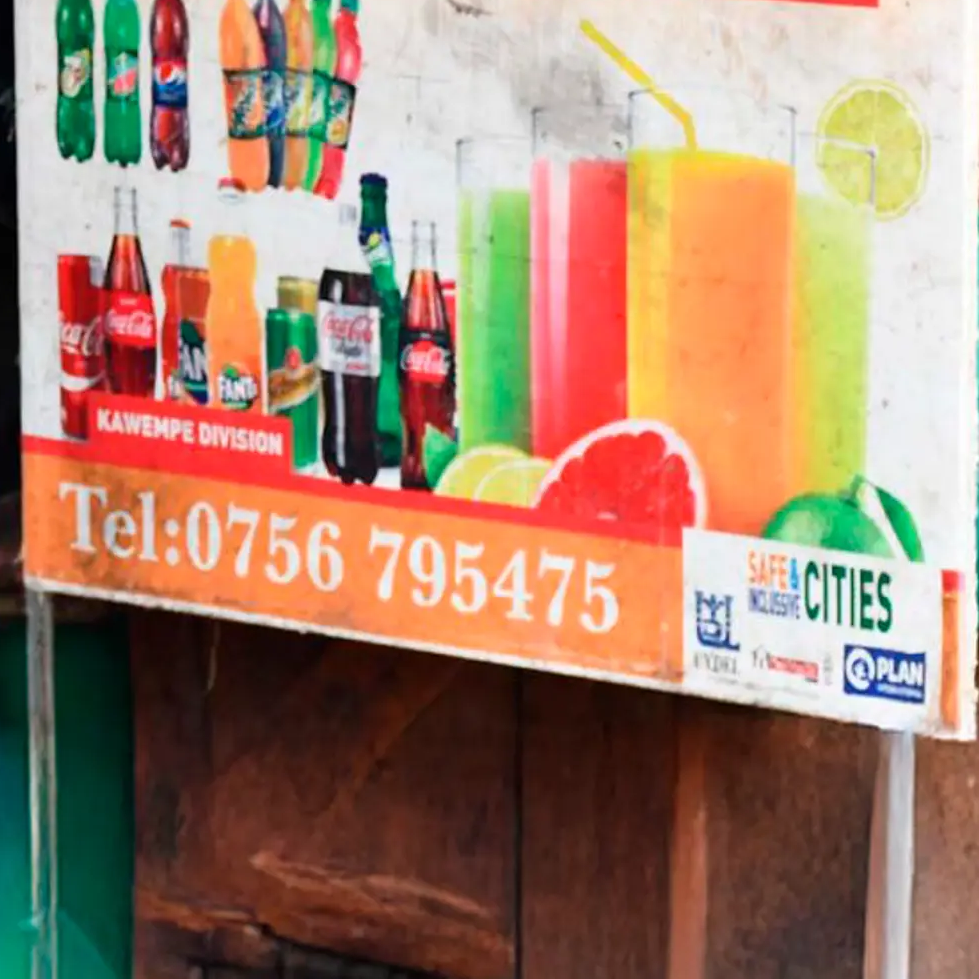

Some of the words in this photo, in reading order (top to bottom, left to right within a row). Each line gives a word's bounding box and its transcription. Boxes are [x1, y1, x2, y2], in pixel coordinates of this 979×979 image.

[97, 409, 194, 444] KAWEMPE
[198, 420, 283, 456] DIVISION
[59, 482, 343, 592] Tel:0756
[369, 526, 620, 634] 795475
[748, 550, 789, 593] SAFE
[804, 560, 893, 633] CITIES
[876, 656, 924, 686] PLAN
